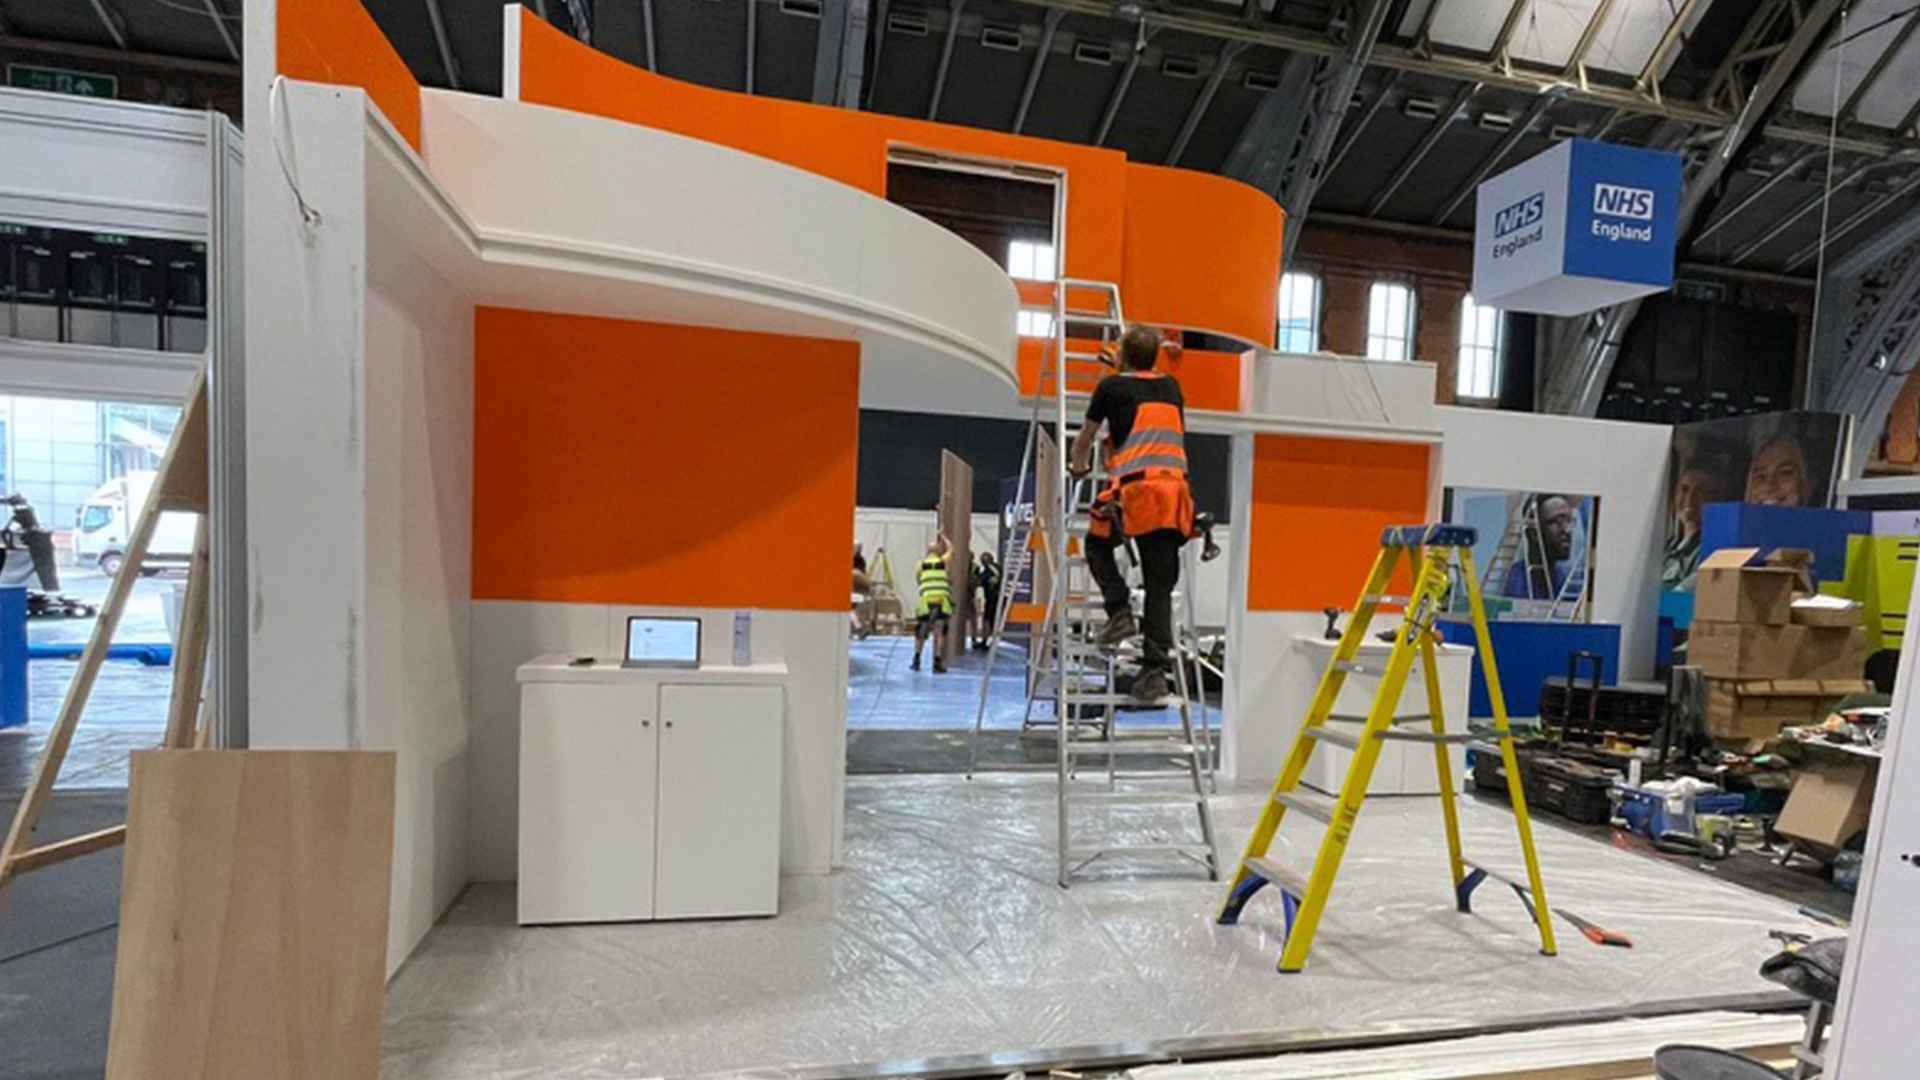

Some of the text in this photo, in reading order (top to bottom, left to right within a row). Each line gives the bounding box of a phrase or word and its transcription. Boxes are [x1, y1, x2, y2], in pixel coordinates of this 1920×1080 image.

[1496, 195, 1542, 236] NHS
[1597, 188, 1651, 216] NHS
[1493, 226, 1542, 258] England
[1592, 220, 1651, 241] England
